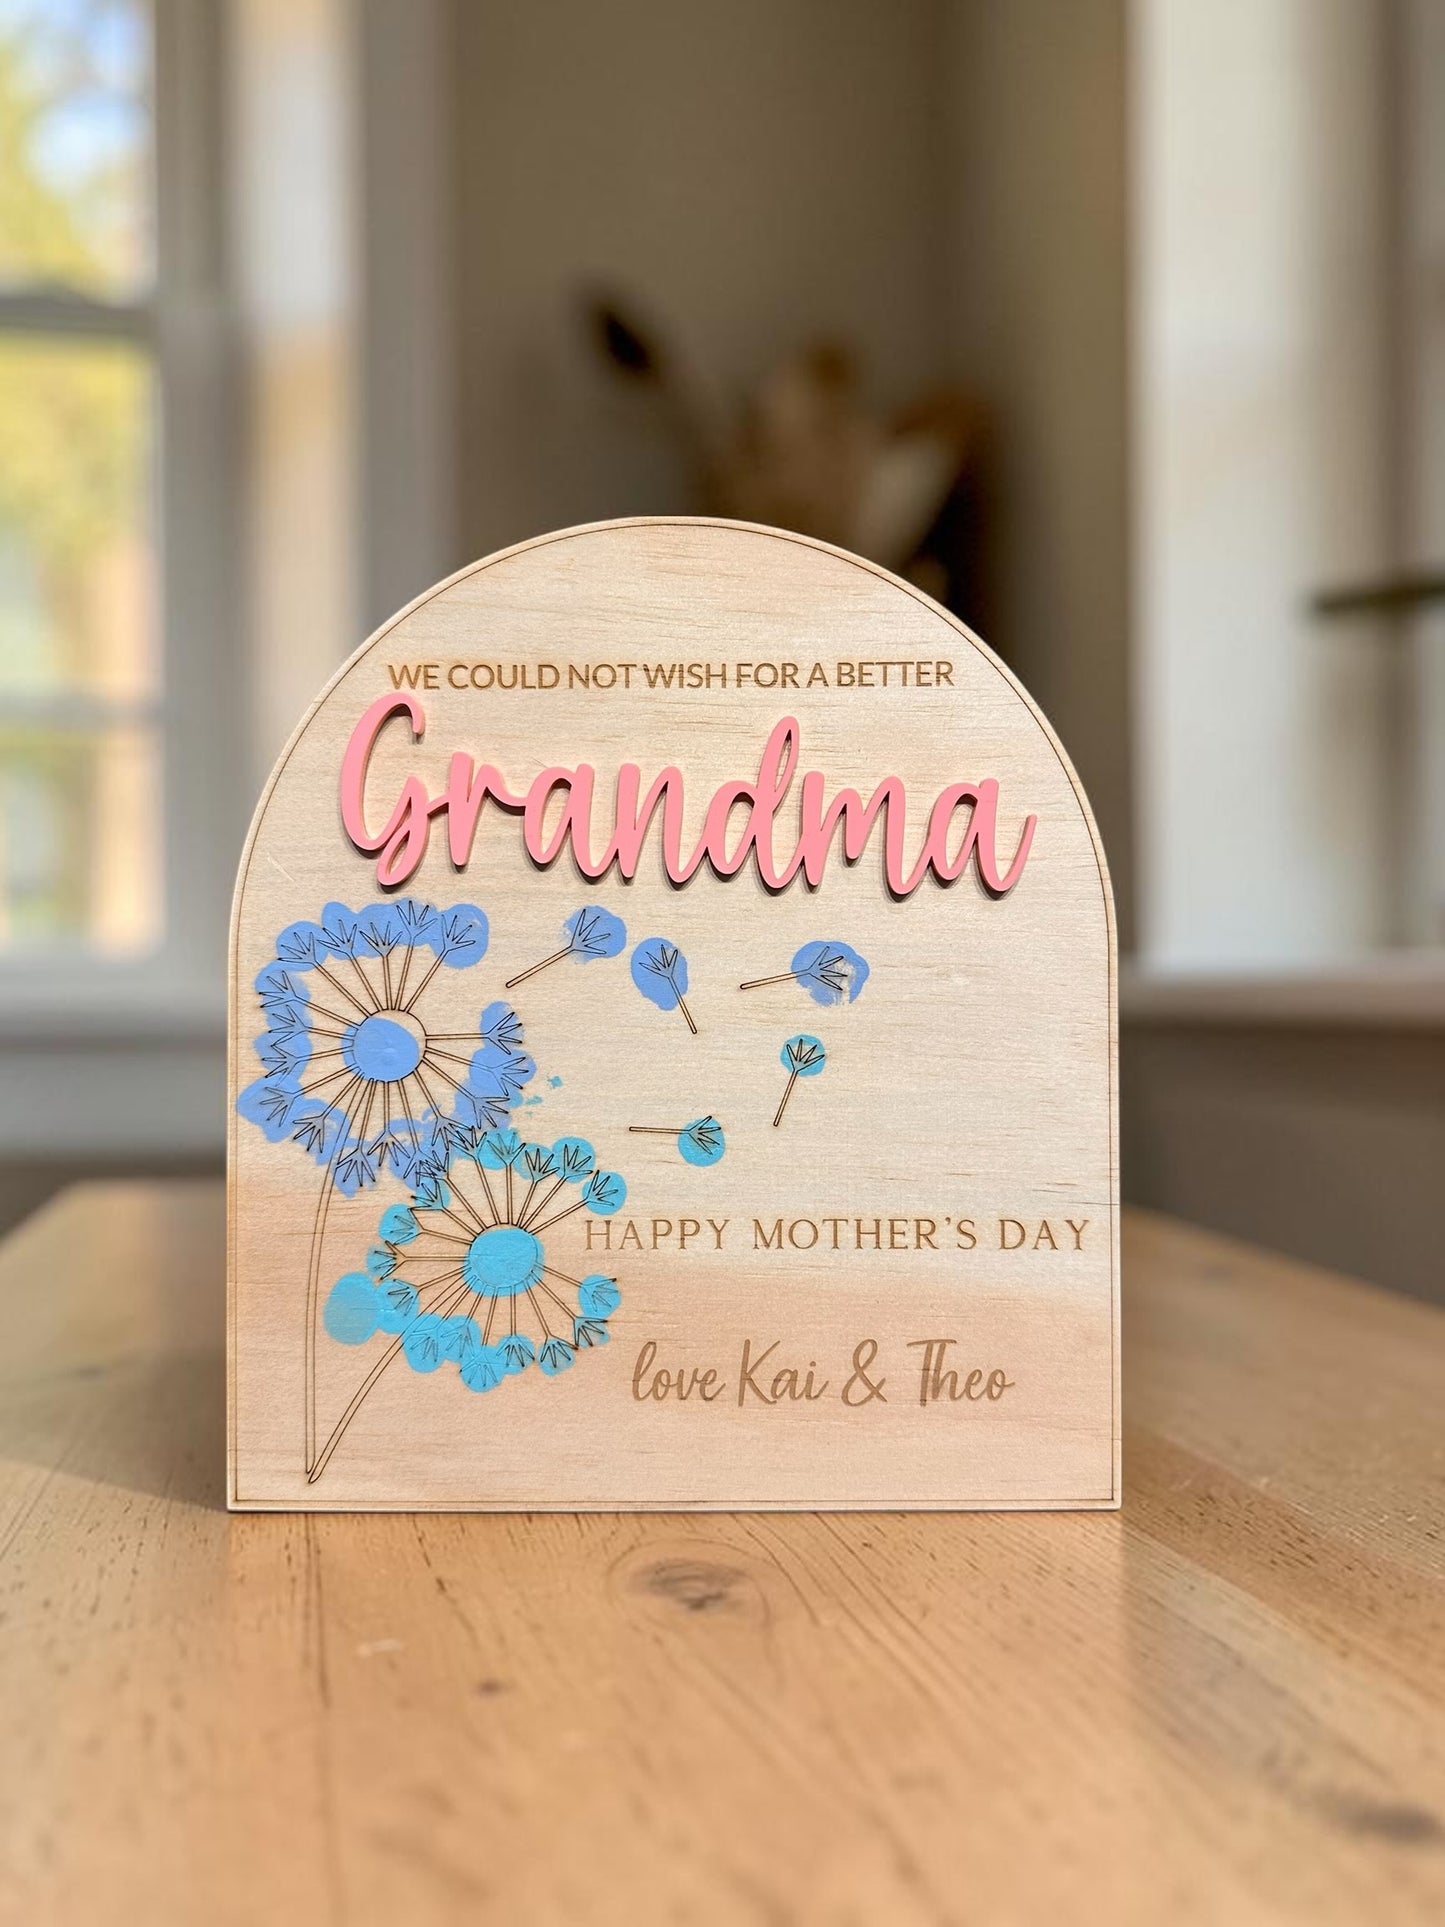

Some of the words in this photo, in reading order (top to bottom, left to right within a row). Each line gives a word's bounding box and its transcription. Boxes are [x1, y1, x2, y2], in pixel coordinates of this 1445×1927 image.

[388, 664, 440, 690] WE
[447, 663, 560, 690] COULD
[567, 663, 637, 689] NOT
[643, 663, 727, 689] WISH
[736, 662, 800, 688] FOR
[806, 662, 829, 688] A
[836, 661, 955, 687] BETTER
[339, 692, 1037, 896] Grandma
[584, 1218, 730, 1251] HAPPY
[752, 1216, 977, 1250] MOTHER’S
[998, 1218, 1091, 1250] DAY
[631, 1340, 726, 1402] love
[737, 1338, 829, 1408] Kai
[840, 1338, 888, 1408] &
[906, 1338, 1016, 1407] Theo
